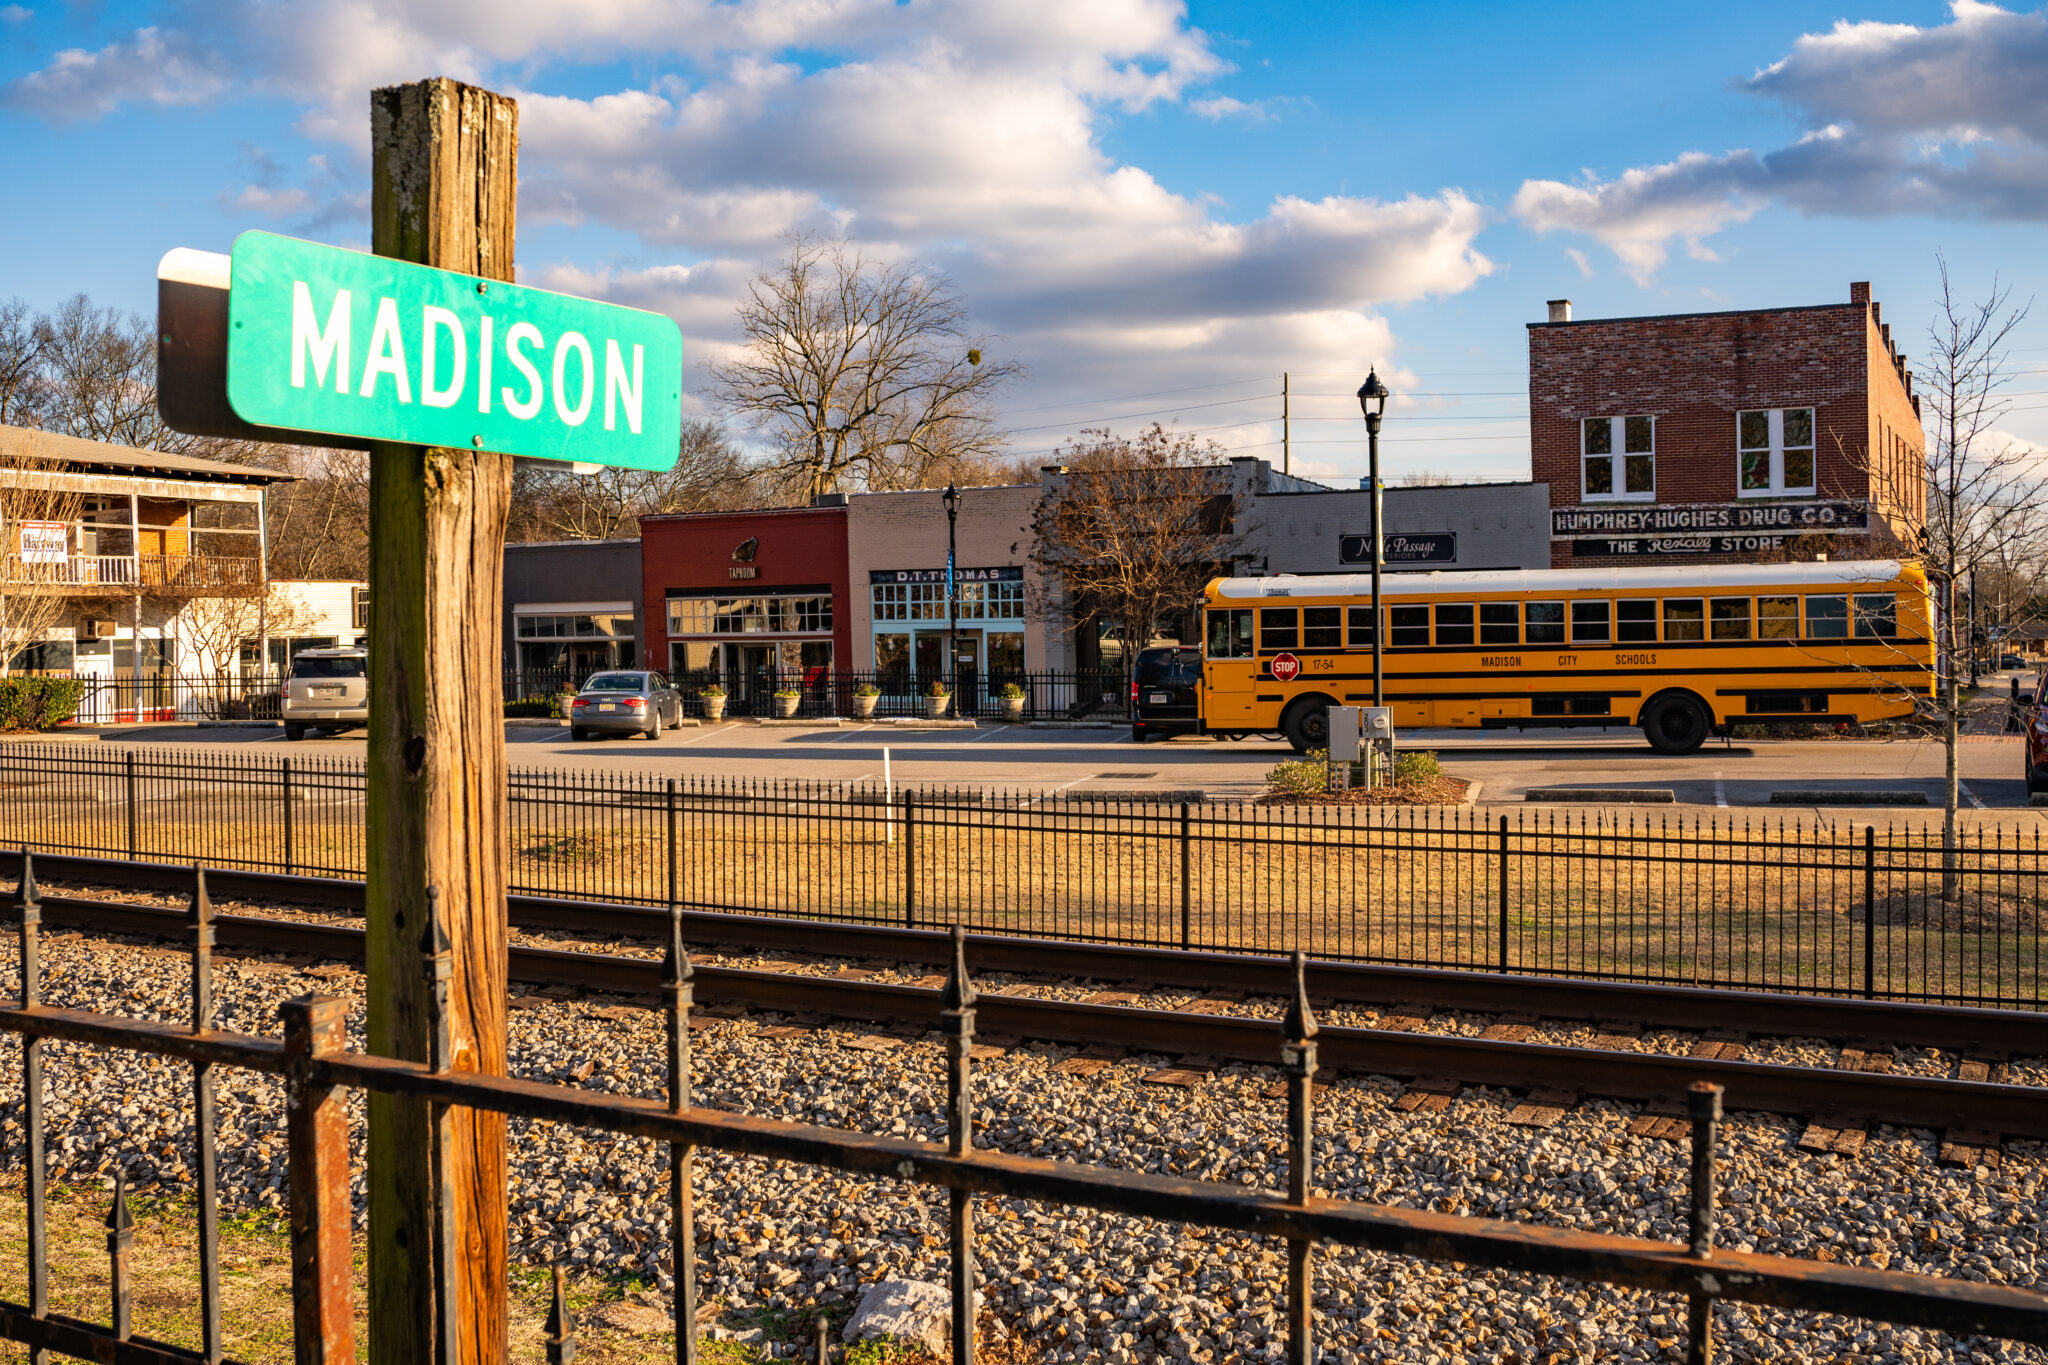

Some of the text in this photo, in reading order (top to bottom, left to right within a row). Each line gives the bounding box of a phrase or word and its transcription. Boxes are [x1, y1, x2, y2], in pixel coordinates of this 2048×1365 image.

[291, 280, 645, 435] MADISON
[1739, 508, 1792, 526] DRUG
[1393, 537, 1436, 559] Passage
[1607, 536, 1784, 553] THE Rexall STORE
[728, 567, 756, 579] TAPROOM
[1275, 661, 1296, 673] STOP
[1313, 659, 1334, 670] 17-54
[1481, 653, 1657, 667] MADISON CITY SCHOOLS
